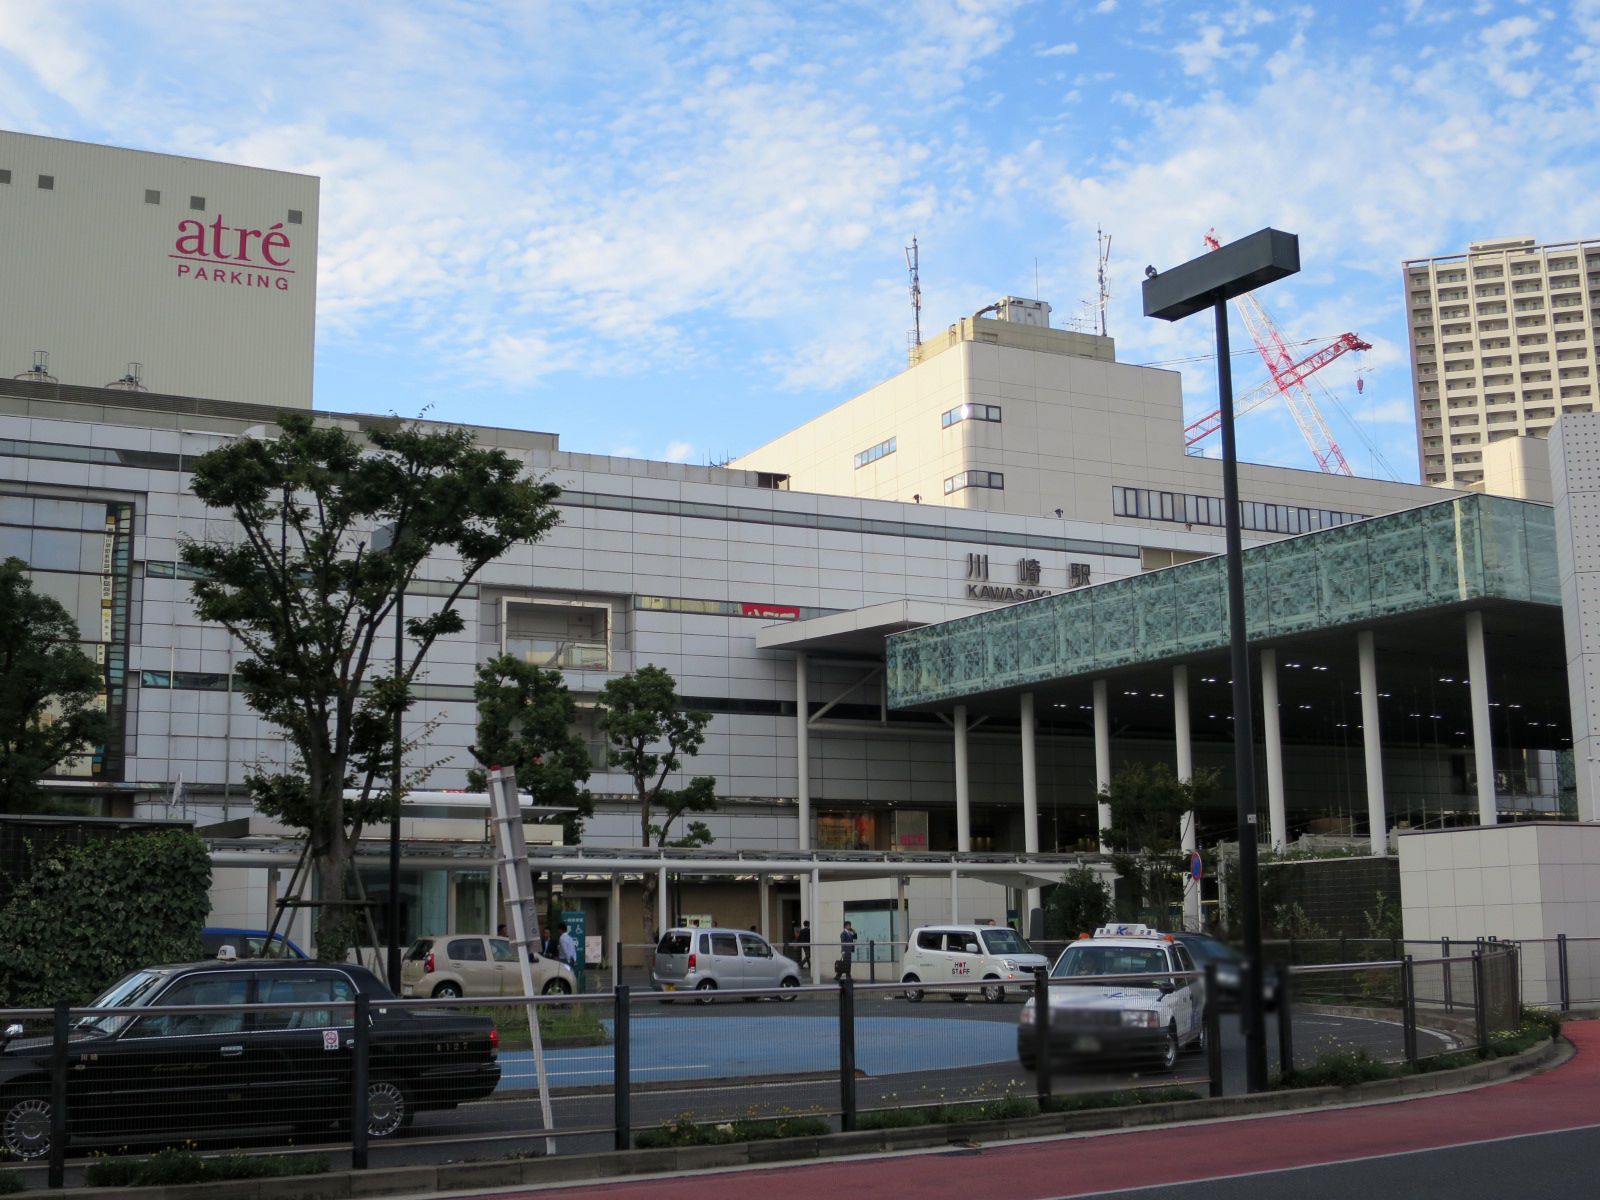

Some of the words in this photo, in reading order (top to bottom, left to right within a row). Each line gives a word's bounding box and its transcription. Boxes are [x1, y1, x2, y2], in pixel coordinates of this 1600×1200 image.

[175, 213, 291, 266] atré
[177, 264, 289, 291] PARKING
[966, 552, 1091, 588] 川崎駅
